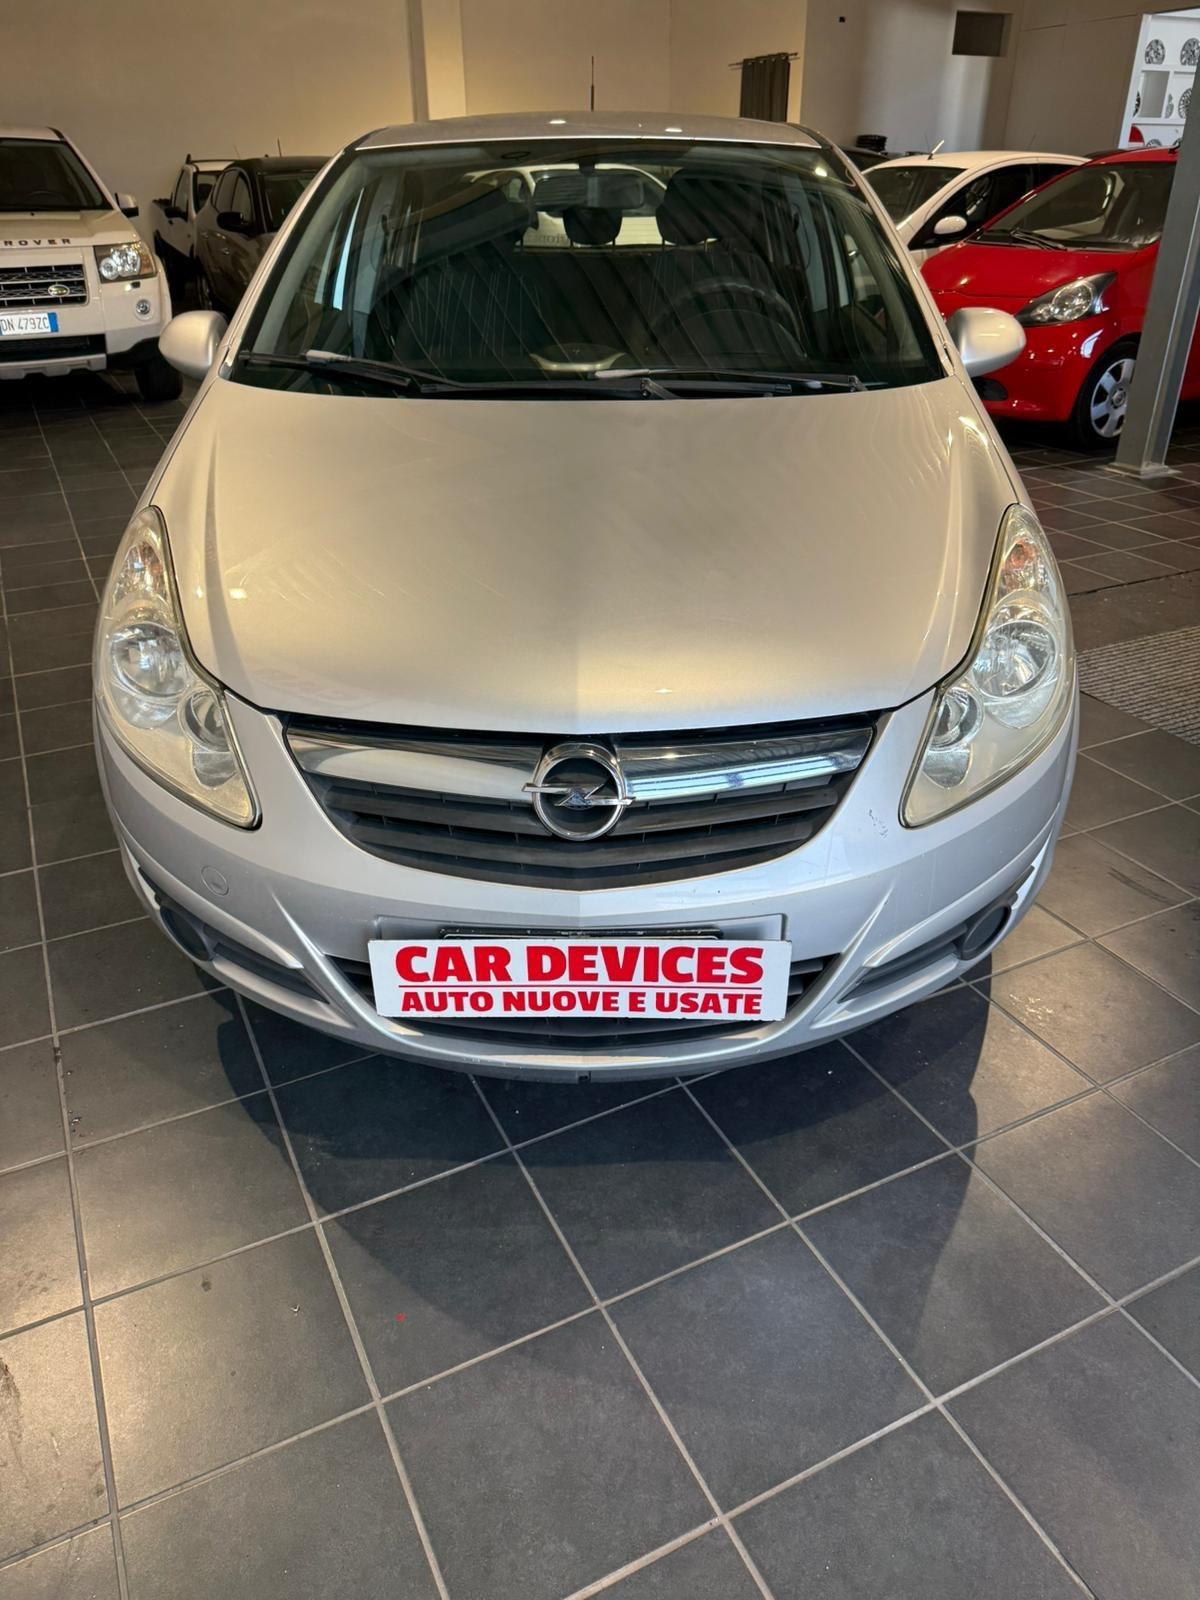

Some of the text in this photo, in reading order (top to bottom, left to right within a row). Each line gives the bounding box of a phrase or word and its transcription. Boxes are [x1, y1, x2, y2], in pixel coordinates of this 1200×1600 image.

[4, 238, 71, 246] ROVER
[18, 317, 50, 330] 479ZC
[394, 945, 763, 985] CAR DEVICES
[400, 991, 761, 1015] AUTO NUOVE E USATE
